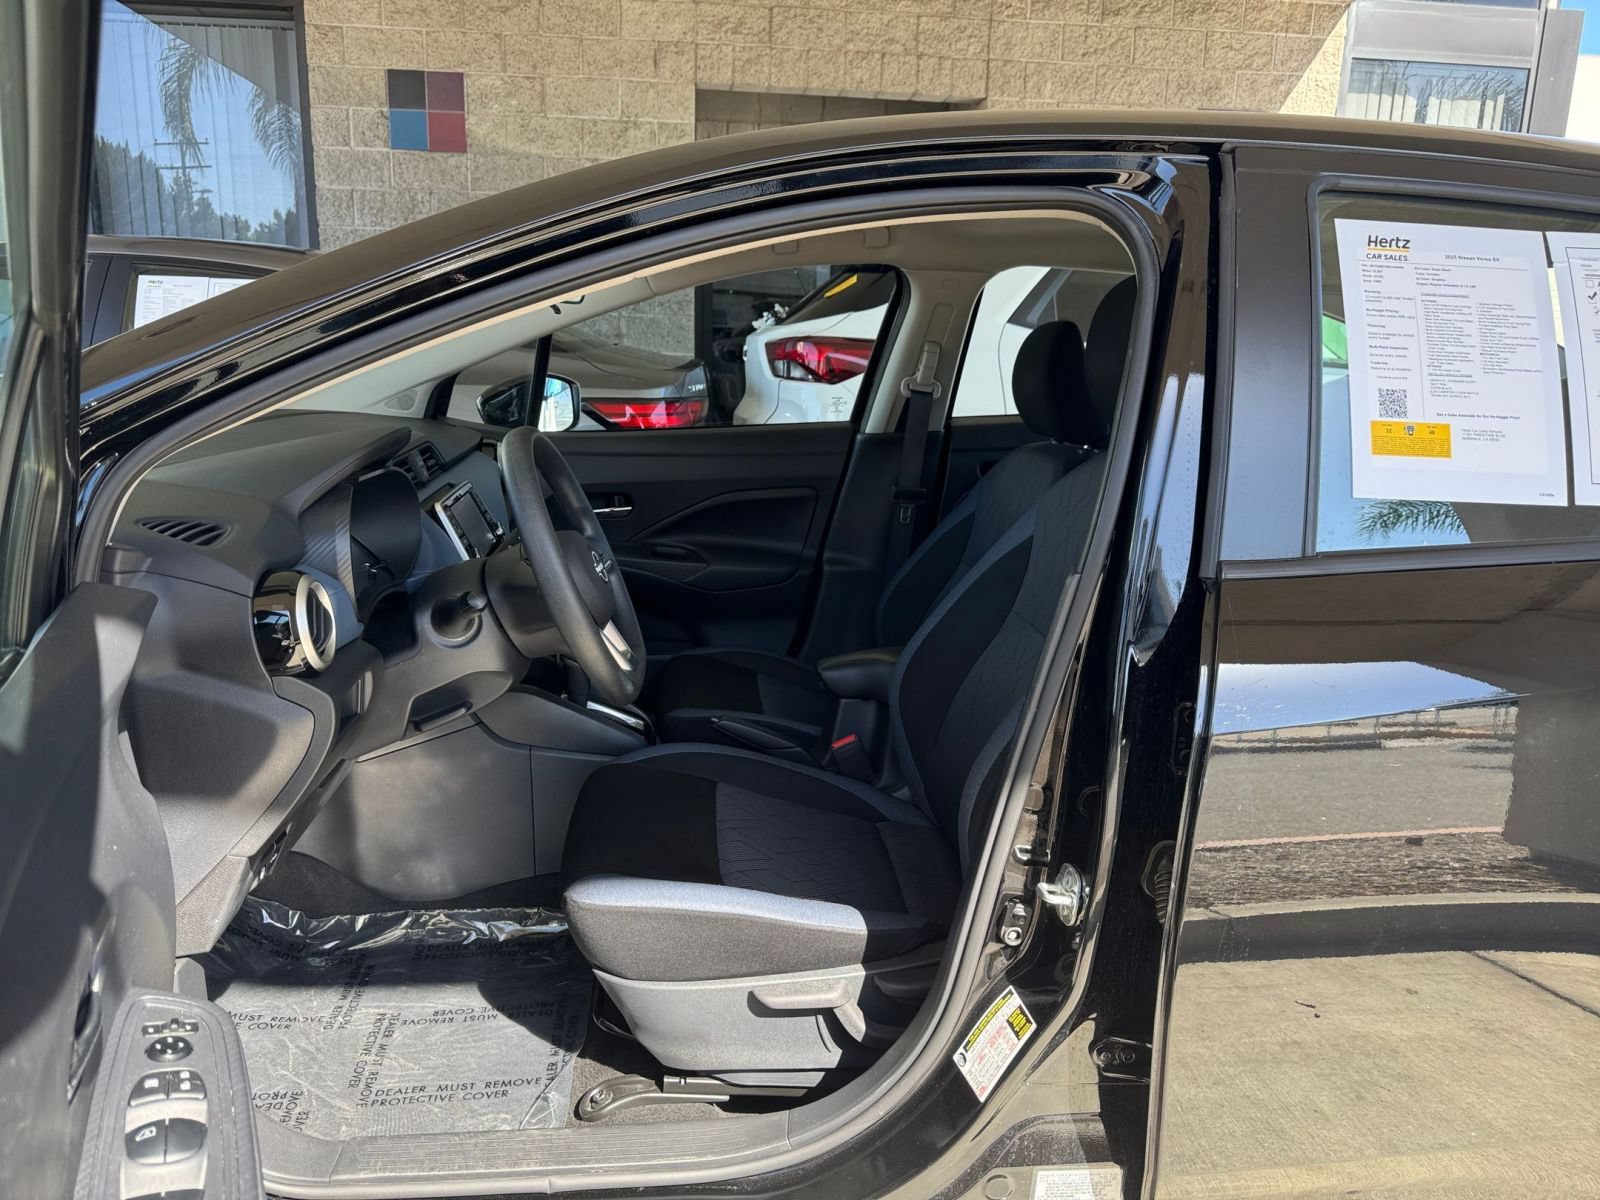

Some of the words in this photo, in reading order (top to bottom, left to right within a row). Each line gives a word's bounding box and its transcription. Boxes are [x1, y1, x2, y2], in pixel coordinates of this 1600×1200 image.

[1367, 234, 1410, 250] Hertz
[270, 1015, 326, 1024] REMOVE
[400, 1017, 455, 1027] REMOVE
[433, 1008, 474, 1017] COVER
[462, 1013, 498, 1024] MUST
[247, 1022, 292, 1031] COVER
[359, 1013, 386, 1057] PROTECTIVE
[382, 1013, 401, 1038] DEALER
[371, 1044, 389, 1066] MUST
[347, 1060, 367, 1088] COVER
[356, 1071, 379, 1108] REMOVE
[375, 1084, 427, 1098] DEALER
[437, 1081, 476, 1092] MUST
[484, 1077, 542, 1089] REMOVE
[280, 1091, 303, 1123] EMOVE
[371, 1094, 459, 1107] PROTECTIVE
[462, 1089, 509, 1100] COVER
